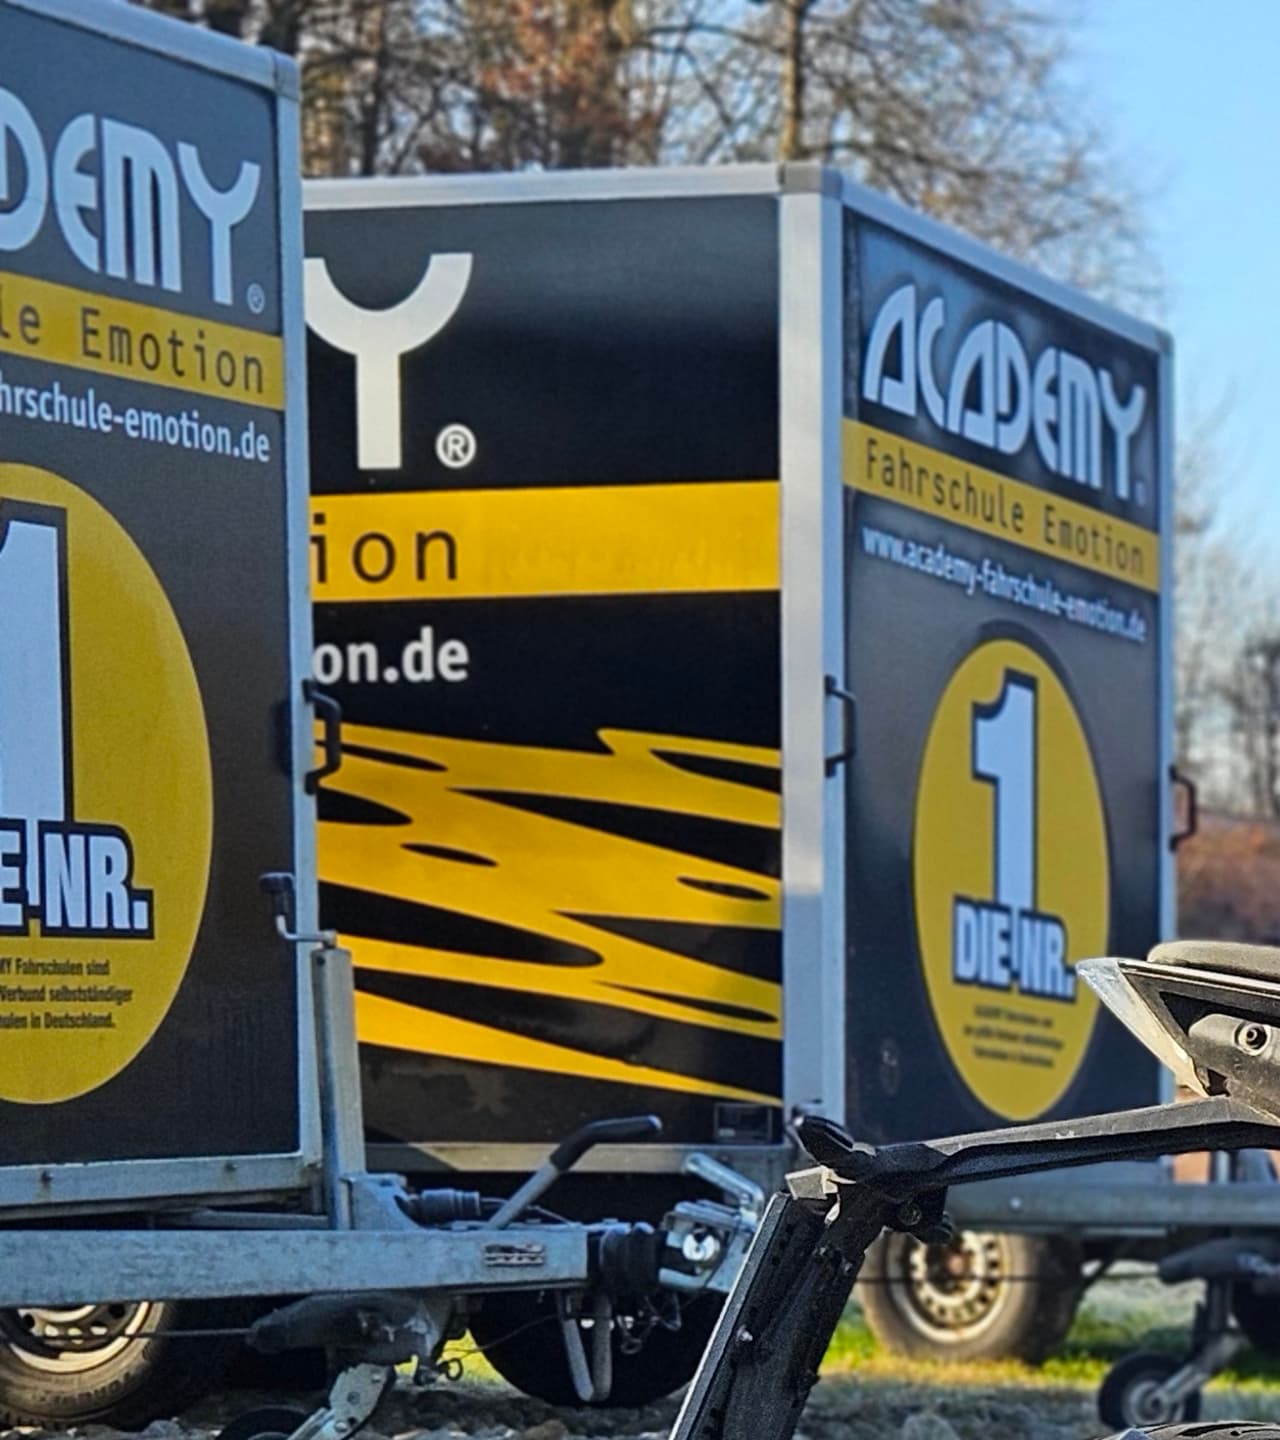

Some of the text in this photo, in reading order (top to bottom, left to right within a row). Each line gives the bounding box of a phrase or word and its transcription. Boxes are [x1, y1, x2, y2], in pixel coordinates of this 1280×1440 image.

[81, 306, 263, 394] Emotion
[862, 284, 1145, 498] ACADEMY
[866, 438, 1144, 575] Fahrschule Emotion
[862, 526, 1147, 643] www.academy-fahrschule-emotion.de
[976, 680, 1036, 908] 1
[44, 833, 149, 930] NR.
[957, 902, 1076, 998] DIE NR.
